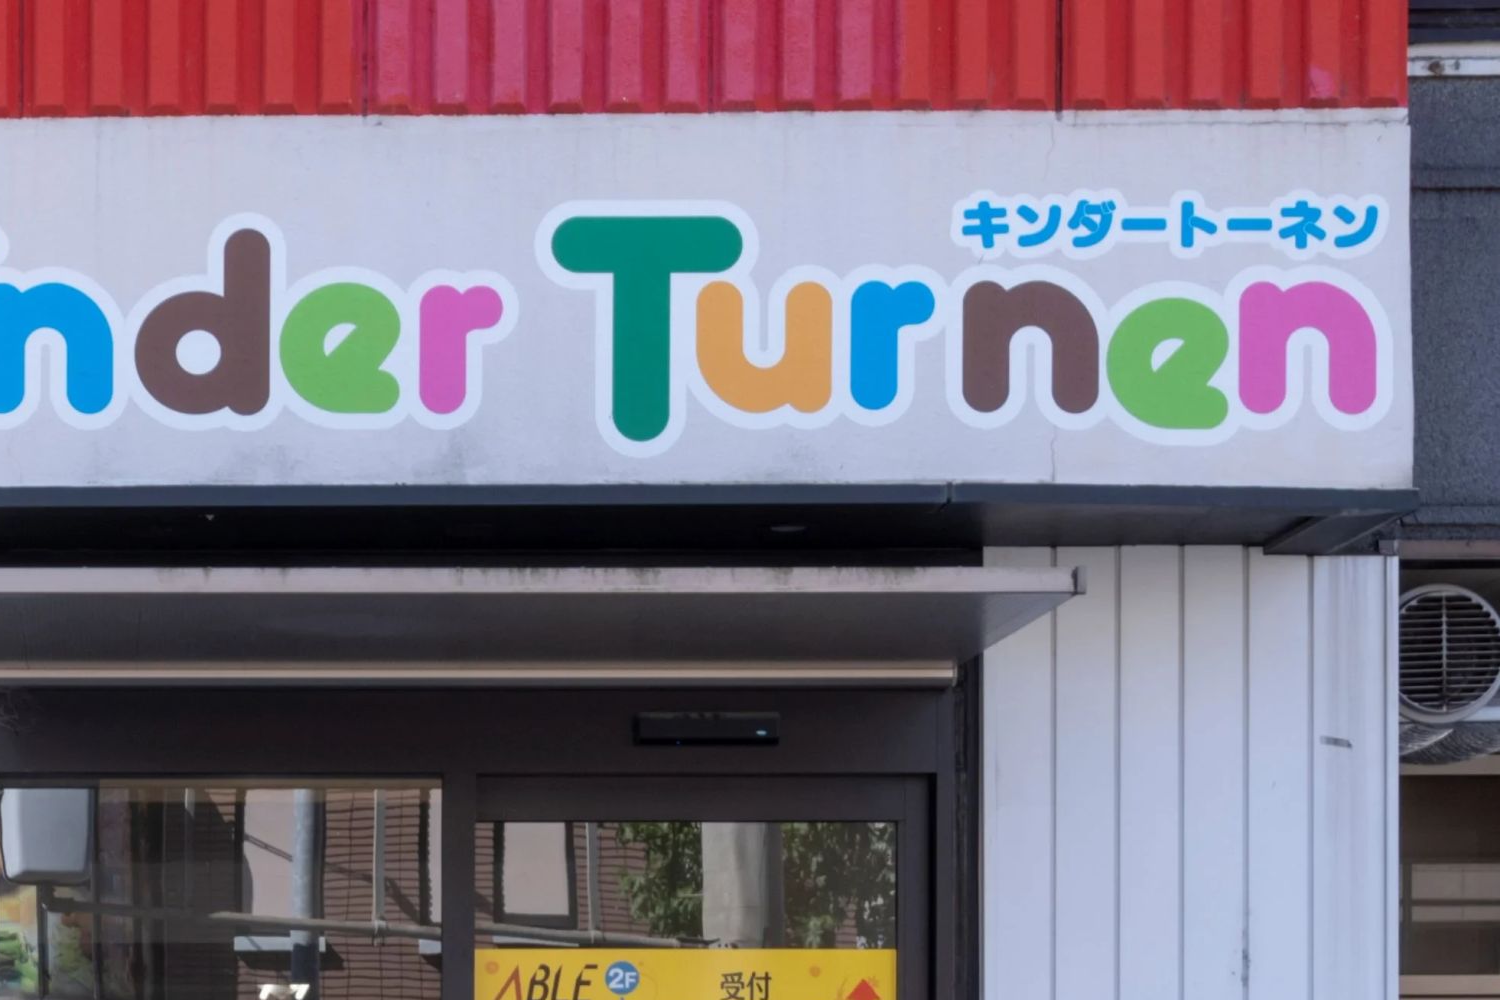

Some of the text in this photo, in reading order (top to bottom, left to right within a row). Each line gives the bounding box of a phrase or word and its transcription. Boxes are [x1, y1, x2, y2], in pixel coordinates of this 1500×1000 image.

[960, 200, 1380, 250] キンダートーネン
[550, 215, 1378, 442] Turnen
[608, 967, 637, 989] 2F
